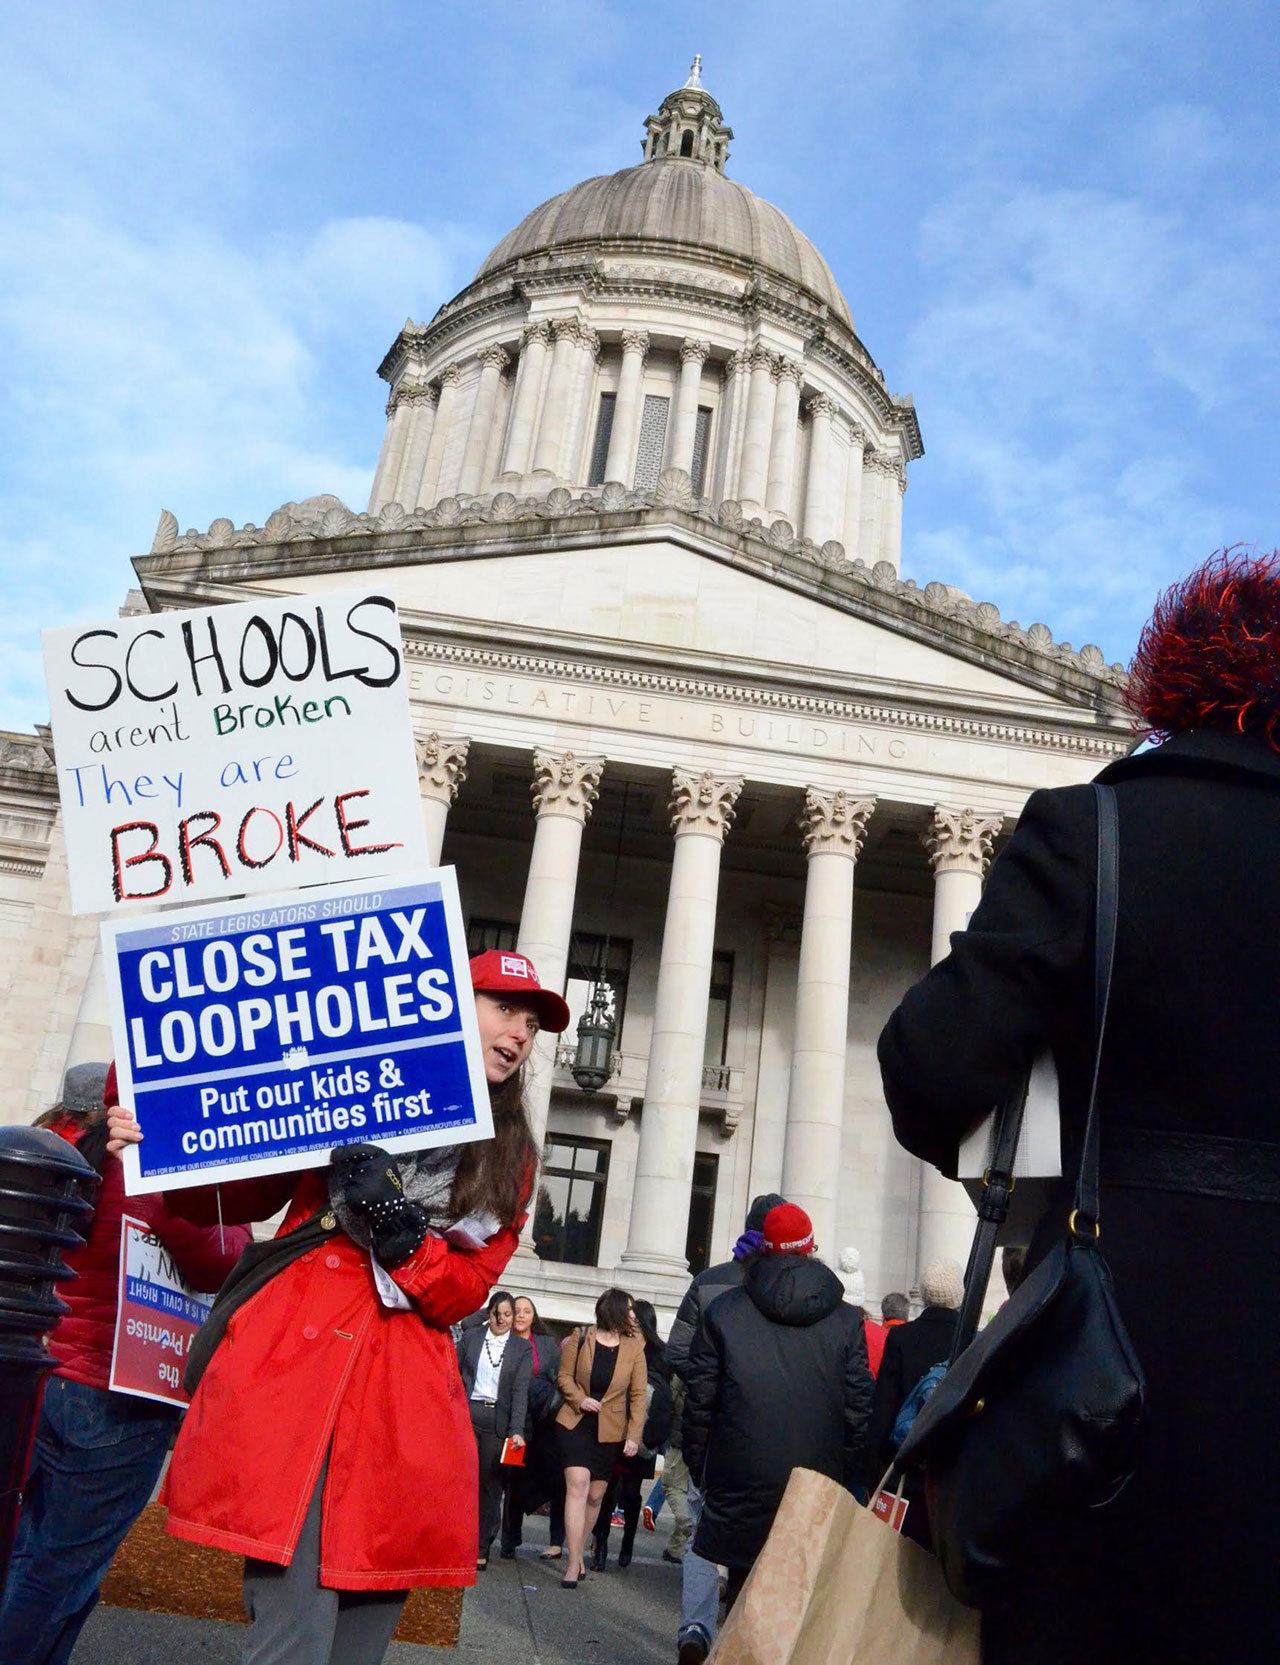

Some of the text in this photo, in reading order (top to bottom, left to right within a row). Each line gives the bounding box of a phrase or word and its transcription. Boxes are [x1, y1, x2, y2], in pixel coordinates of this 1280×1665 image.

[64, 595, 402, 712] SCHOOLS
[89, 702, 190, 753] aren't
[711, 713, 906, 759] BUILDING
[66, 753, 299, 808] They are
[110, 789, 404, 902] BROKE
[171, 894, 382, 942] STATE LEGISLATORS SHOULD
[138, 908, 433, 1003] CLOSE TAX
[131, 968, 454, 1069] LOOPHOLES
[200, 1057, 405, 1118] Put our kids &
[181, 1088, 433, 1155] communities first
[157, 1168, 169, 1176] FOR
[187, 1163, 200, 1171] OUR
[200, 1158, 229, 1169] ECONOMIC
[229, 1155, 250, 1165] FUTURE
[249, 1150, 279, 1161] COALITION
[129, 1281, 158, 1302] RIGHT
[161, 1291, 183, 1312] CIVIL
[184, 1301, 190, 1315] A
[191, 1303, 200, 1320] IS
[126, 1317, 184, 1357] Promise
[158, 1362, 180, 1388] the
